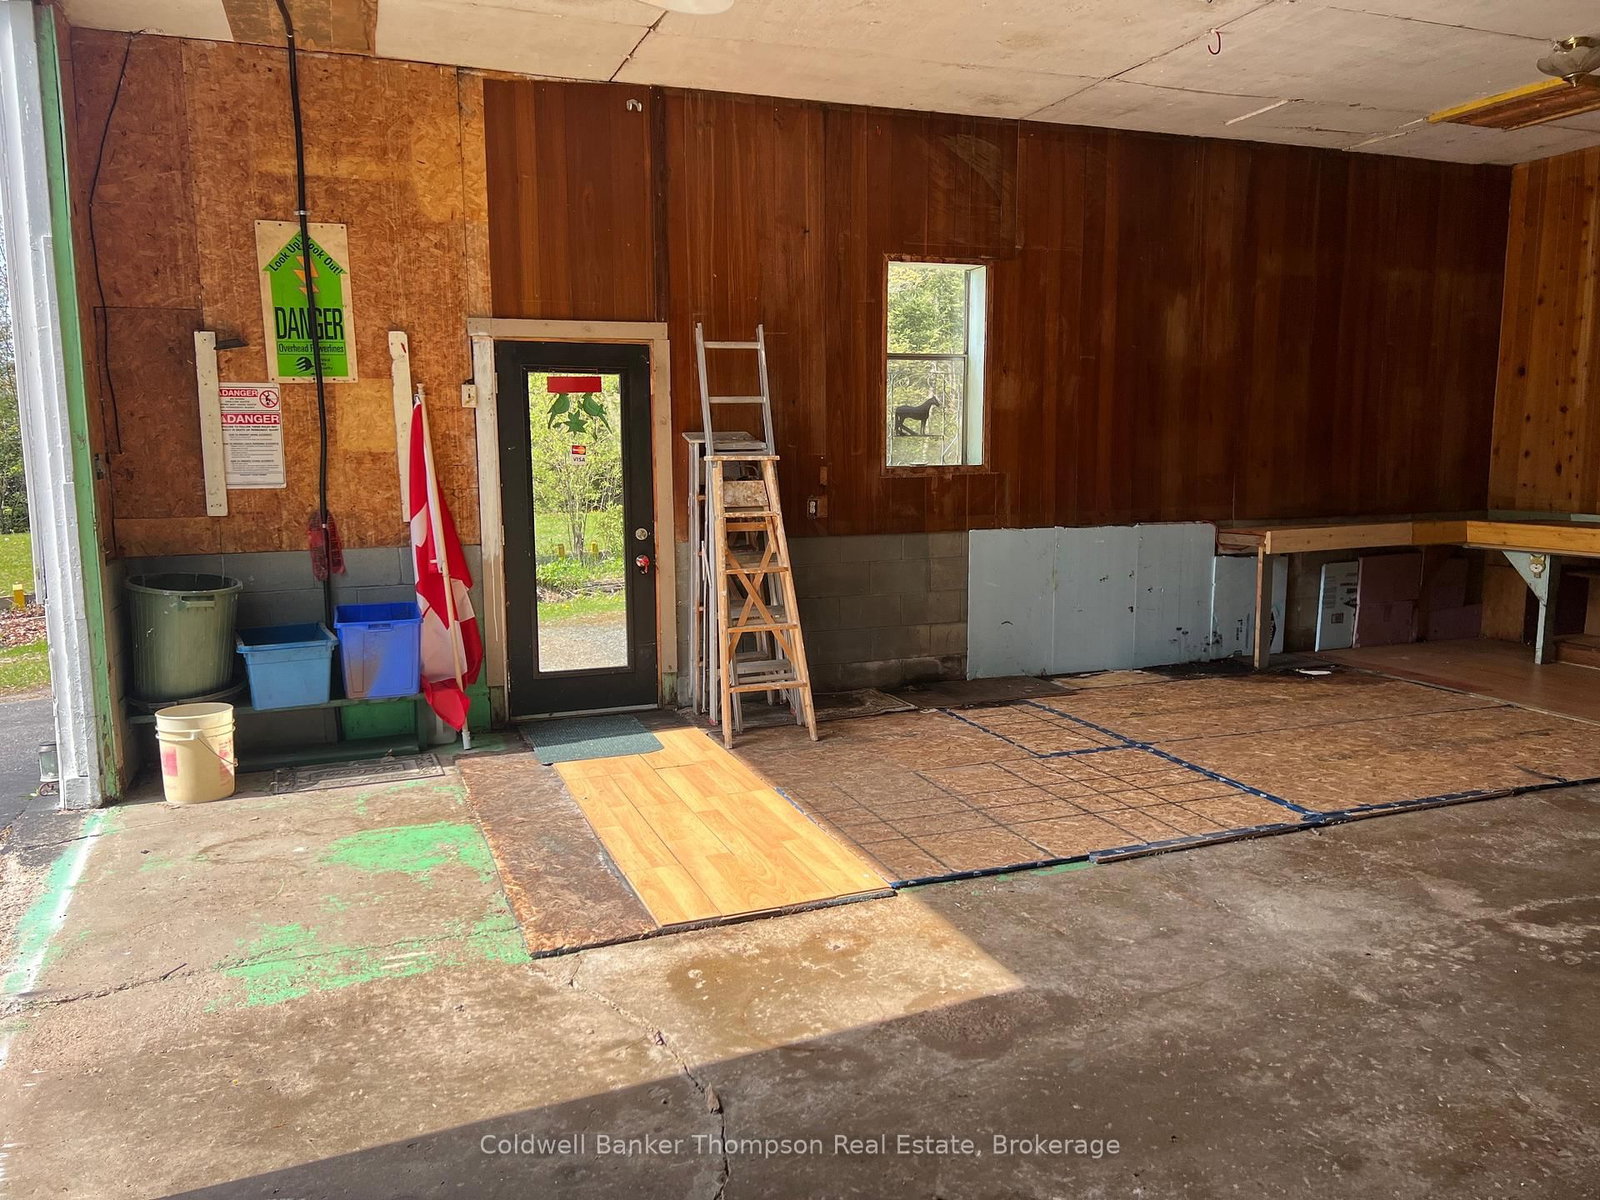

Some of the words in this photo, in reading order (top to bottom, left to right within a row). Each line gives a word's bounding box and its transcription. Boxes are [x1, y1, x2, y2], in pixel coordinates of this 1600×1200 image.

[268, 251, 290, 272] Look
[286, 237, 303, 254] Up!
[306, 236, 325, 259] ook
[323, 257, 345, 276] Out!
[278, 343, 309, 353] Overhead
[310, 344, 344, 353] Pwerlines
[222, 389, 258, 397] DANGER
[227, 414, 280, 424] DANGER
